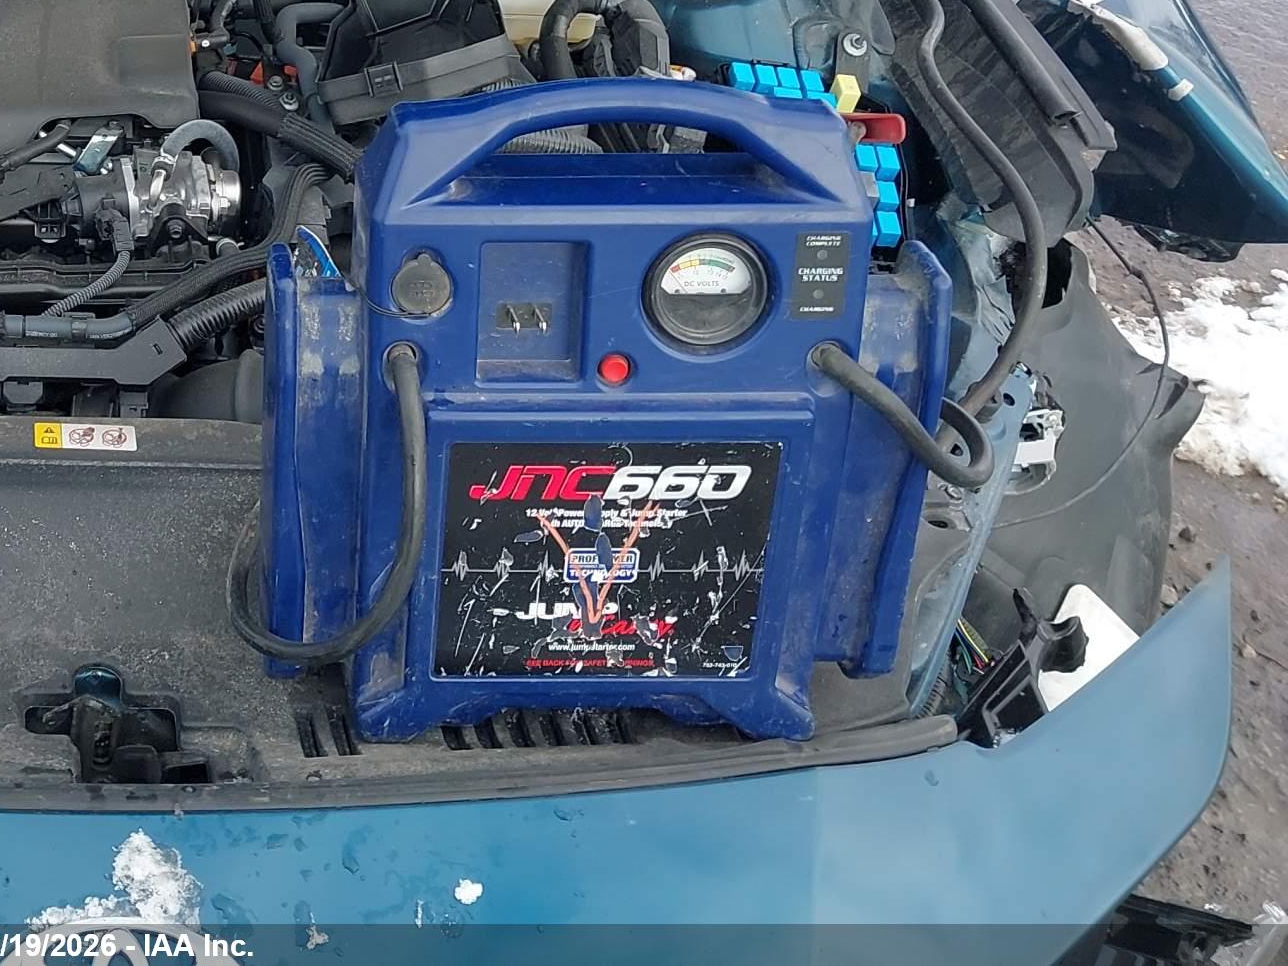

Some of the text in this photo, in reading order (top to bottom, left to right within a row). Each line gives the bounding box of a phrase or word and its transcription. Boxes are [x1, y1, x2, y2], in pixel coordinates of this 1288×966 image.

[798, 267, 844, 275] CHARGING
[469, 465, 752, 501] JNC660
[571, 554, 633, 563] PROFER
